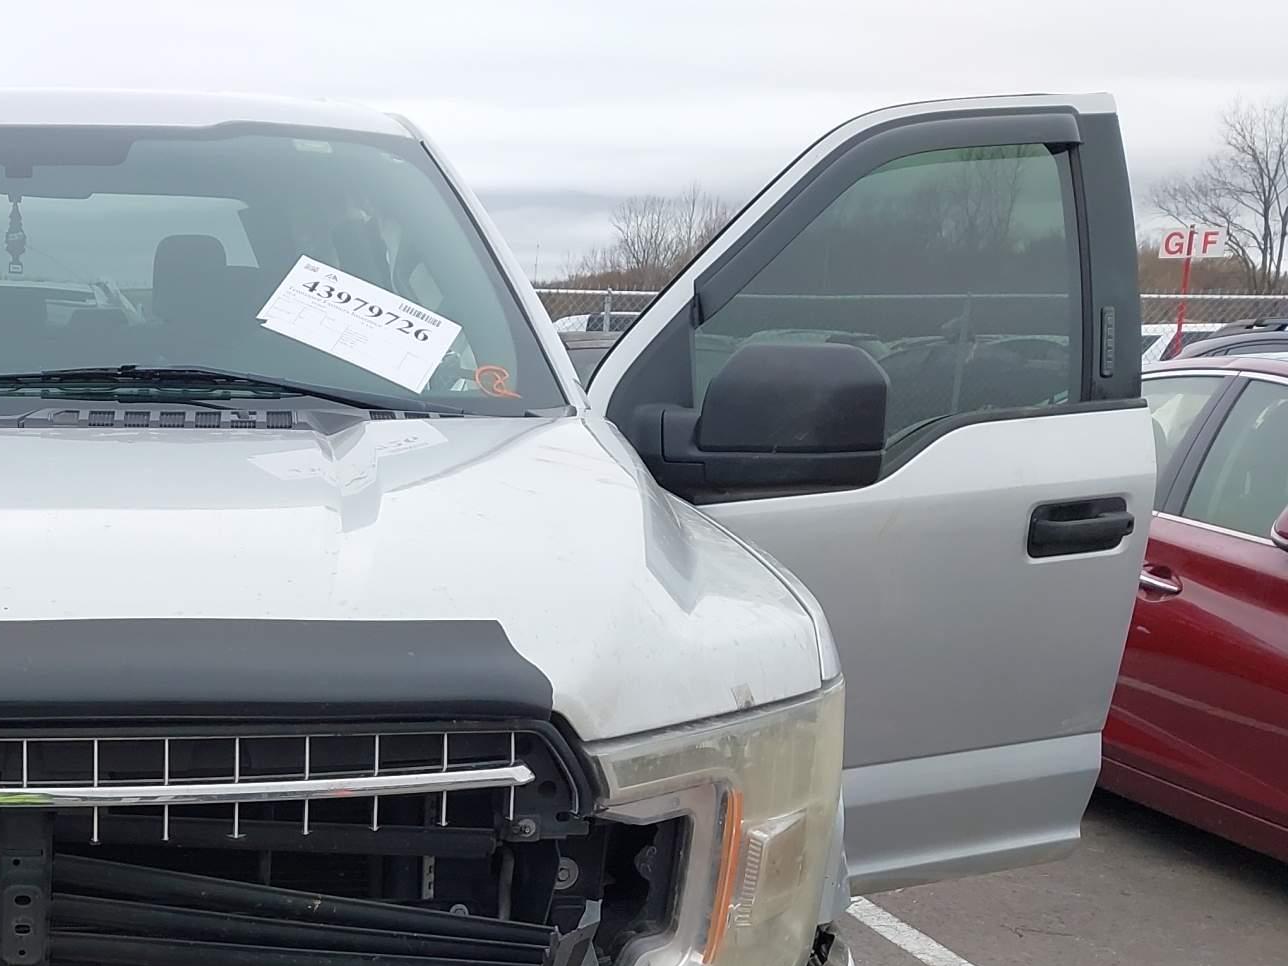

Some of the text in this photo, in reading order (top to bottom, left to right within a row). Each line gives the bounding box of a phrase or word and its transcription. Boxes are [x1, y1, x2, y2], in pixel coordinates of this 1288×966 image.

[1164, 231, 1185, 255] G
[1202, 231, 1219, 254] F
[302, 280, 429, 342] 43979726
